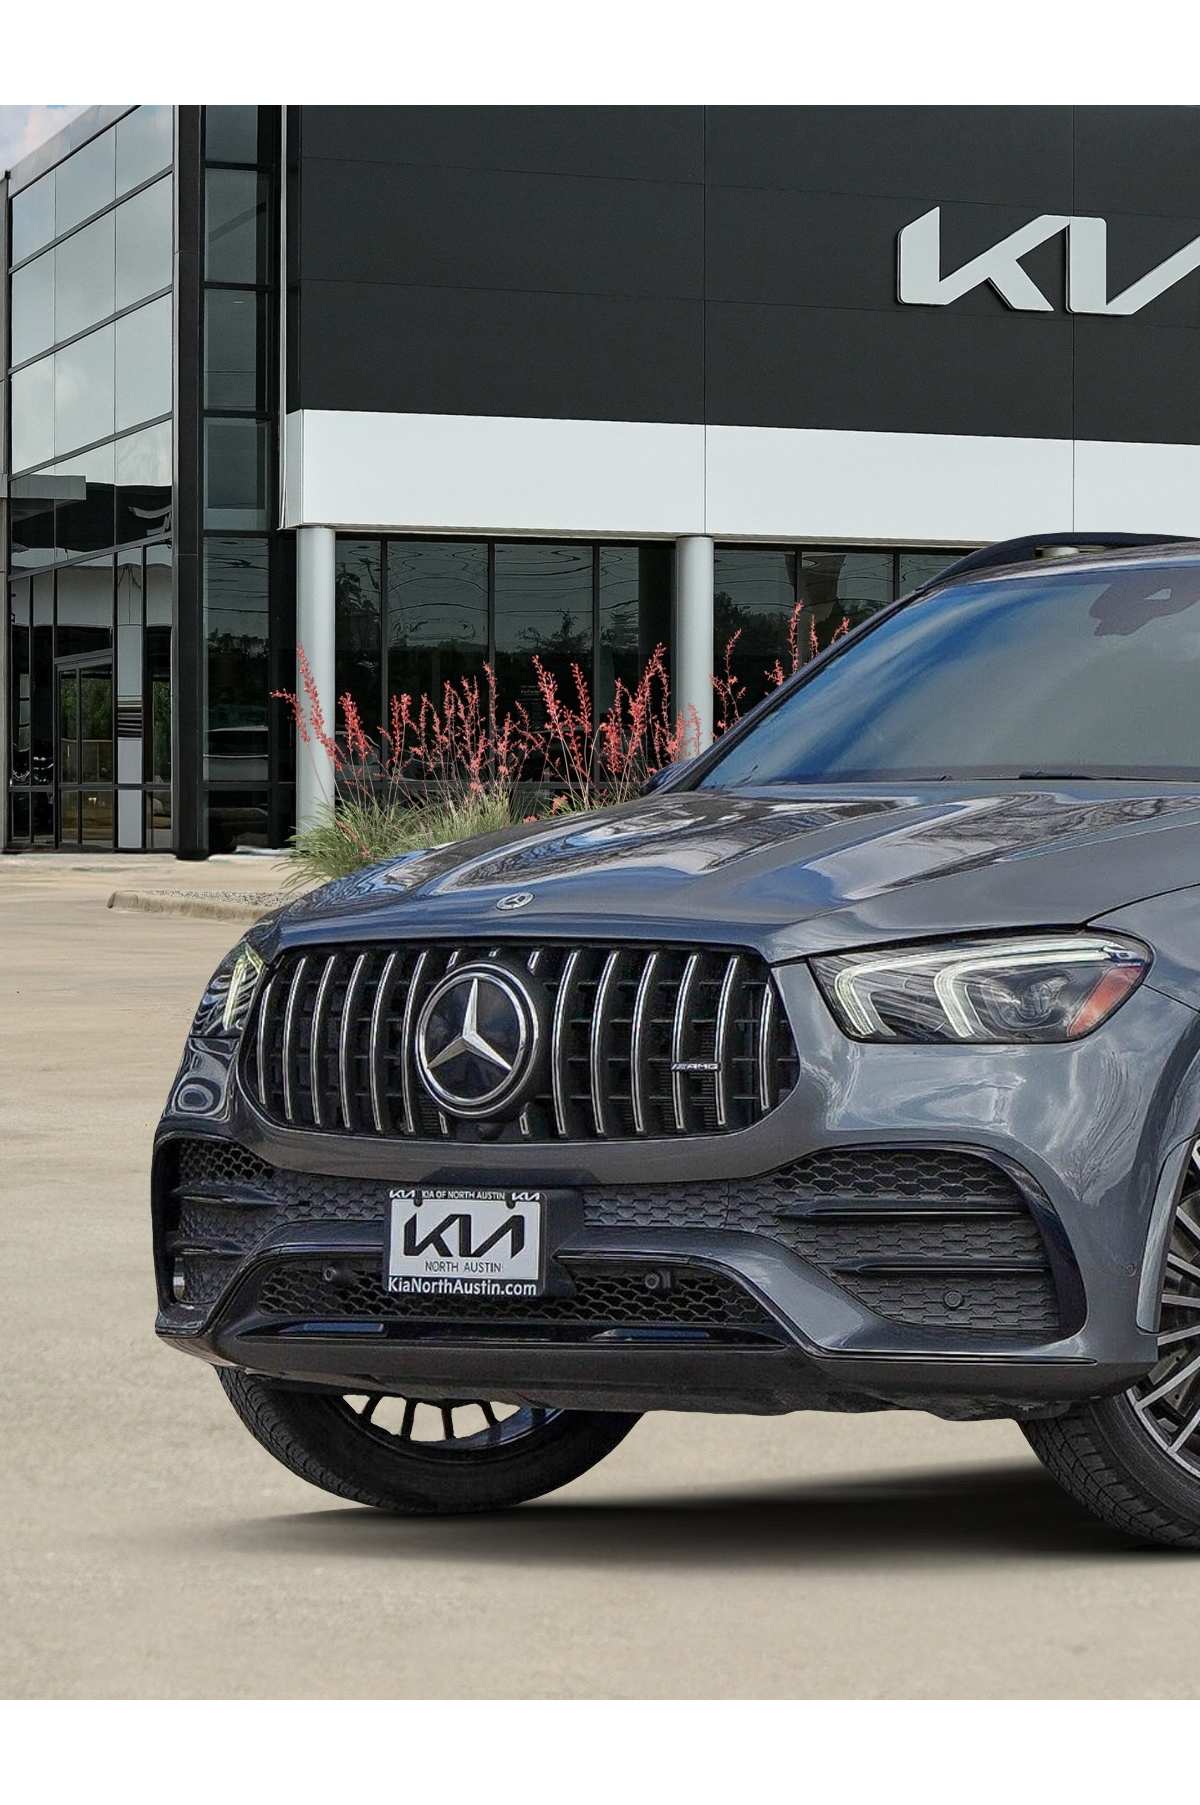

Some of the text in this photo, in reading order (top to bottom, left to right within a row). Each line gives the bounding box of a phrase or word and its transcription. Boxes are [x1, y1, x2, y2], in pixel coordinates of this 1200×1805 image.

[389, 1189, 416, 1199] KIA
[421, 1189, 506, 1201] KIA OF NORTH AUSTIN
[511, 1191, 541, 1201] KIA
[403, 1213, 525, 1259] KIA
[424, 1260, 502, 1274] NORTH AUSTIN
[387, 1276, 537, 1296] KiaNorthAustin.com
